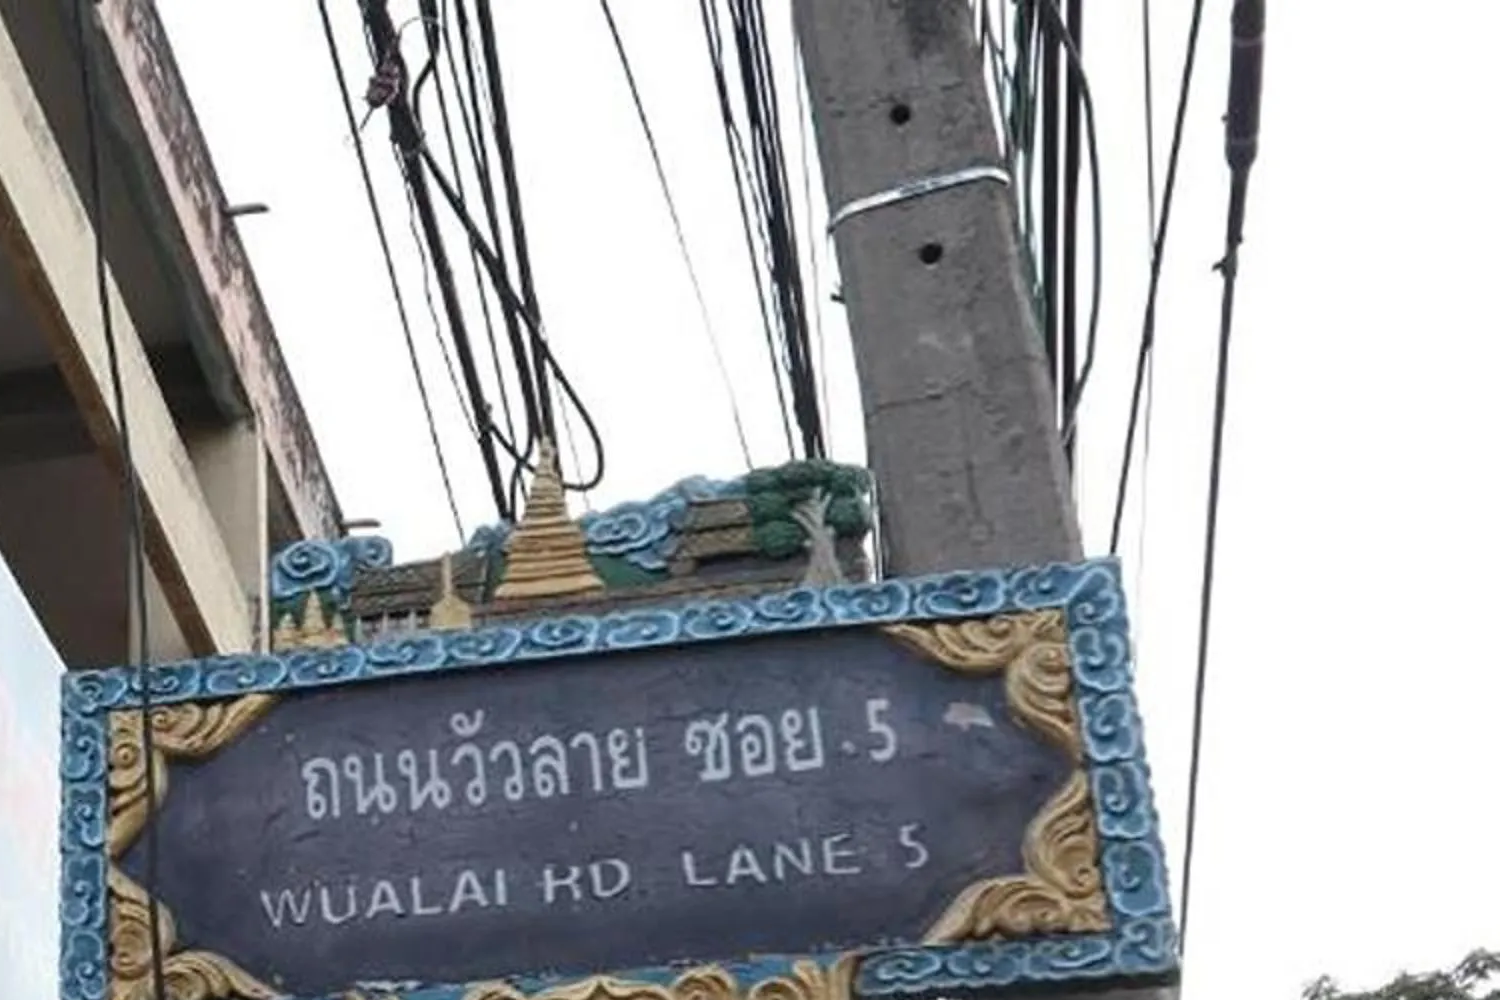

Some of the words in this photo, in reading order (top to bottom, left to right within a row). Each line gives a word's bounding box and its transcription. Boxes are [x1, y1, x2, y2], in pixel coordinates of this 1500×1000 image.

[302, 709, 648, 819] ถนนวัวลาย
[685, 704, 824, 782] ซอย
[260, 868, 506, 928] WUALAI
[682, 833, 862, 886] LANE
[898, 822, 930, 868] 5
